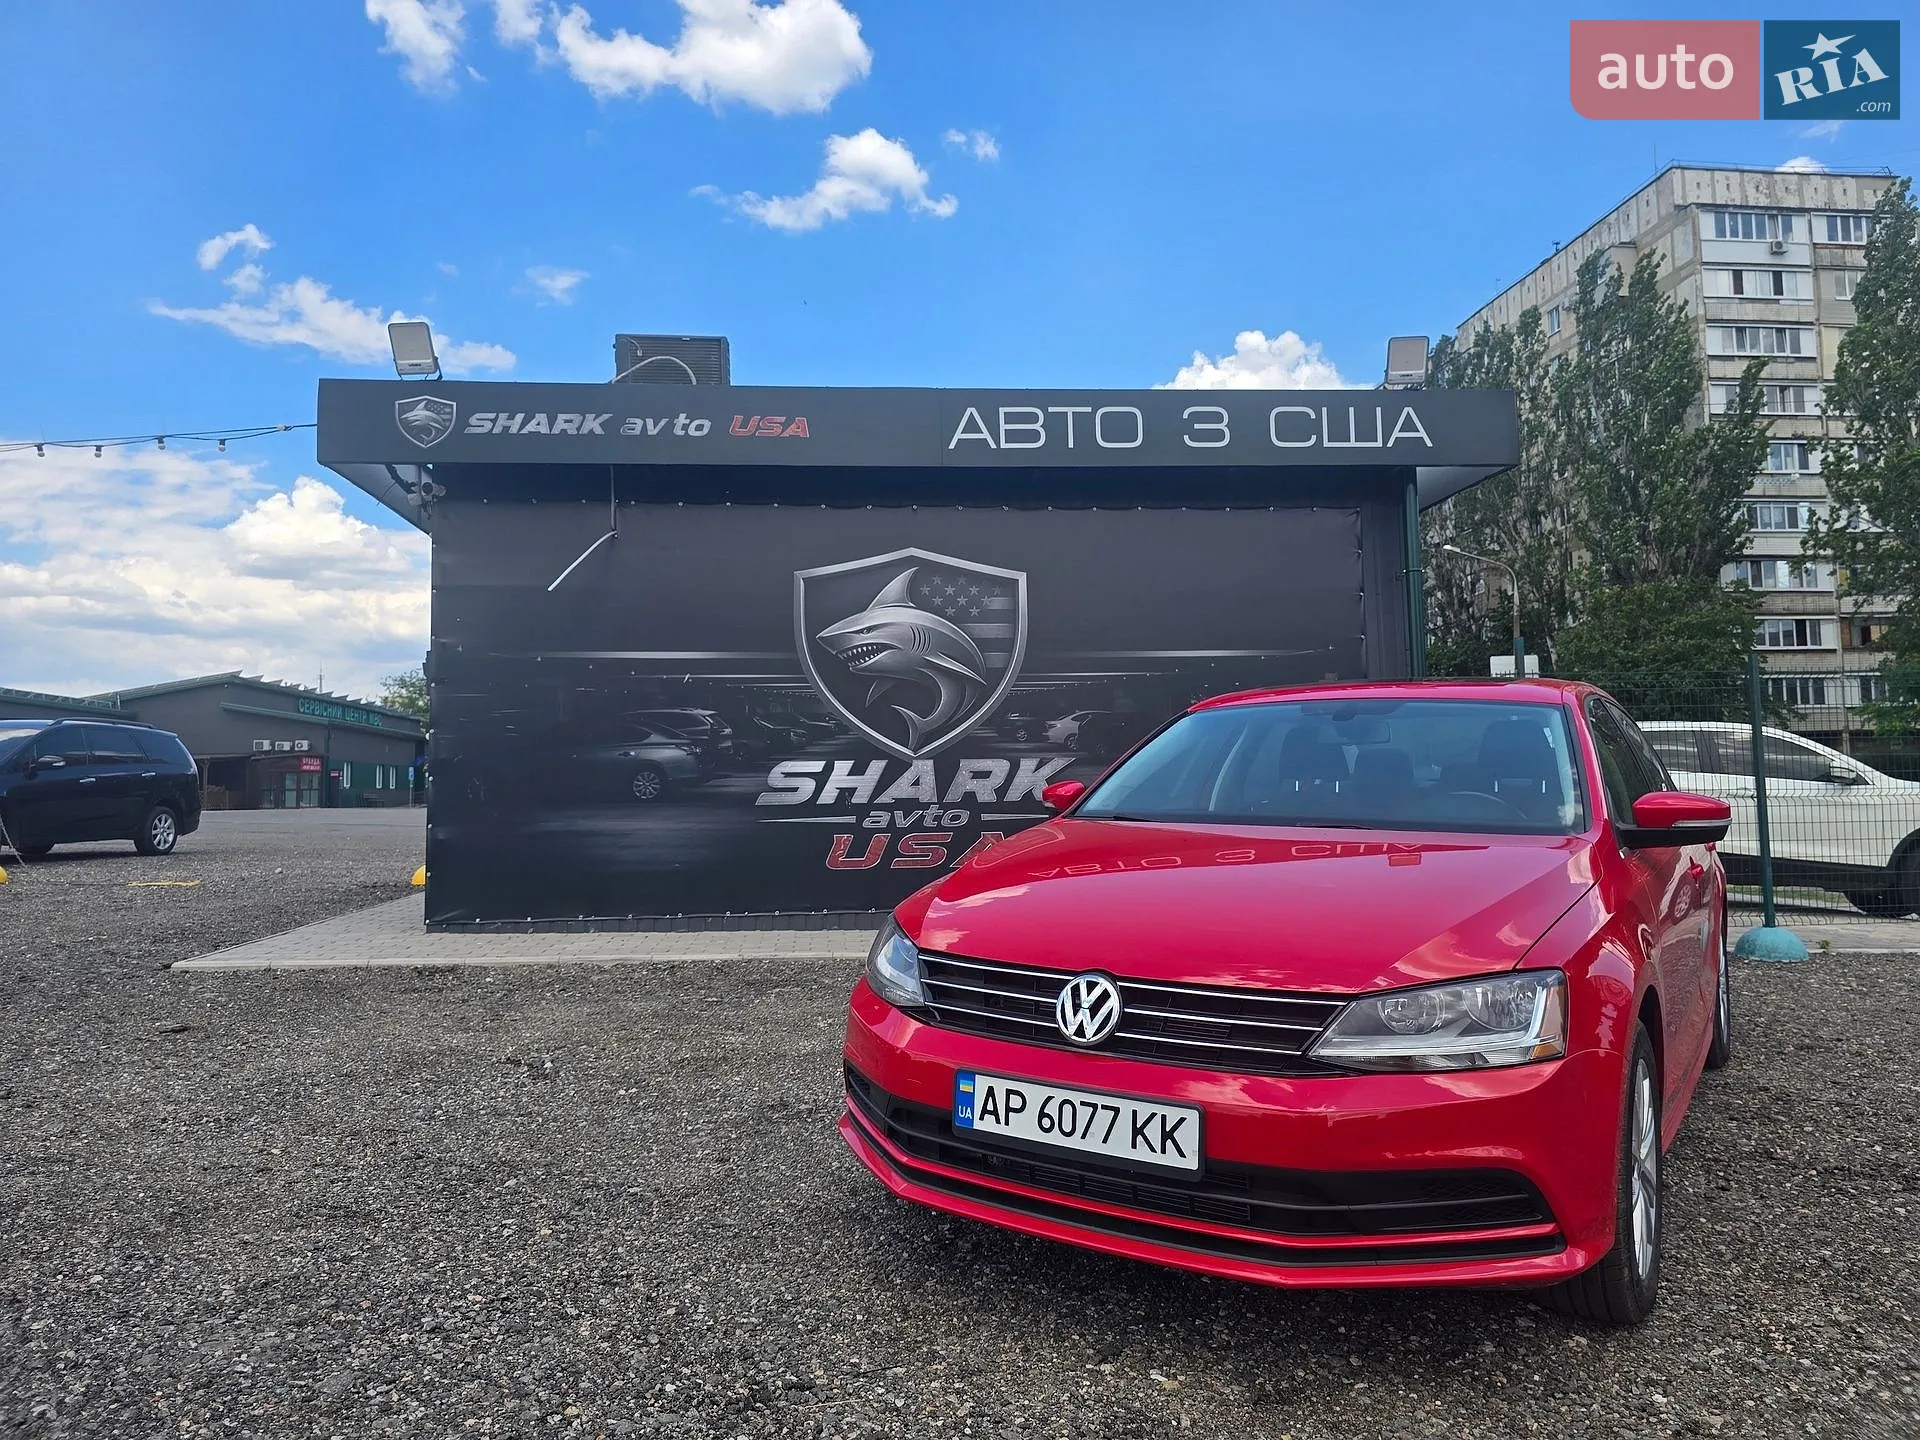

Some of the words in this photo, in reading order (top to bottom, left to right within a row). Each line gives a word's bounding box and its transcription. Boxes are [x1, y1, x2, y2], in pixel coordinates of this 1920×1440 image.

[464, 412, 613, 435] SHARK
[728, 415, 810, 439] USA
[947, 406, 1145, 449] АВТО
[1182, 406, 1232, 448] З
[1269, 406, 1433, 448] США
[755, 758, 1076, 806] SHARK
[862, 804, 970, 828] avto
[958, 1105, 972, 1120] UA
[979, 1085, 1027, 1126] AP
[1037, 1095, 1121, 1144] 6077
[1131, 1109, 1188, 1158] KK
